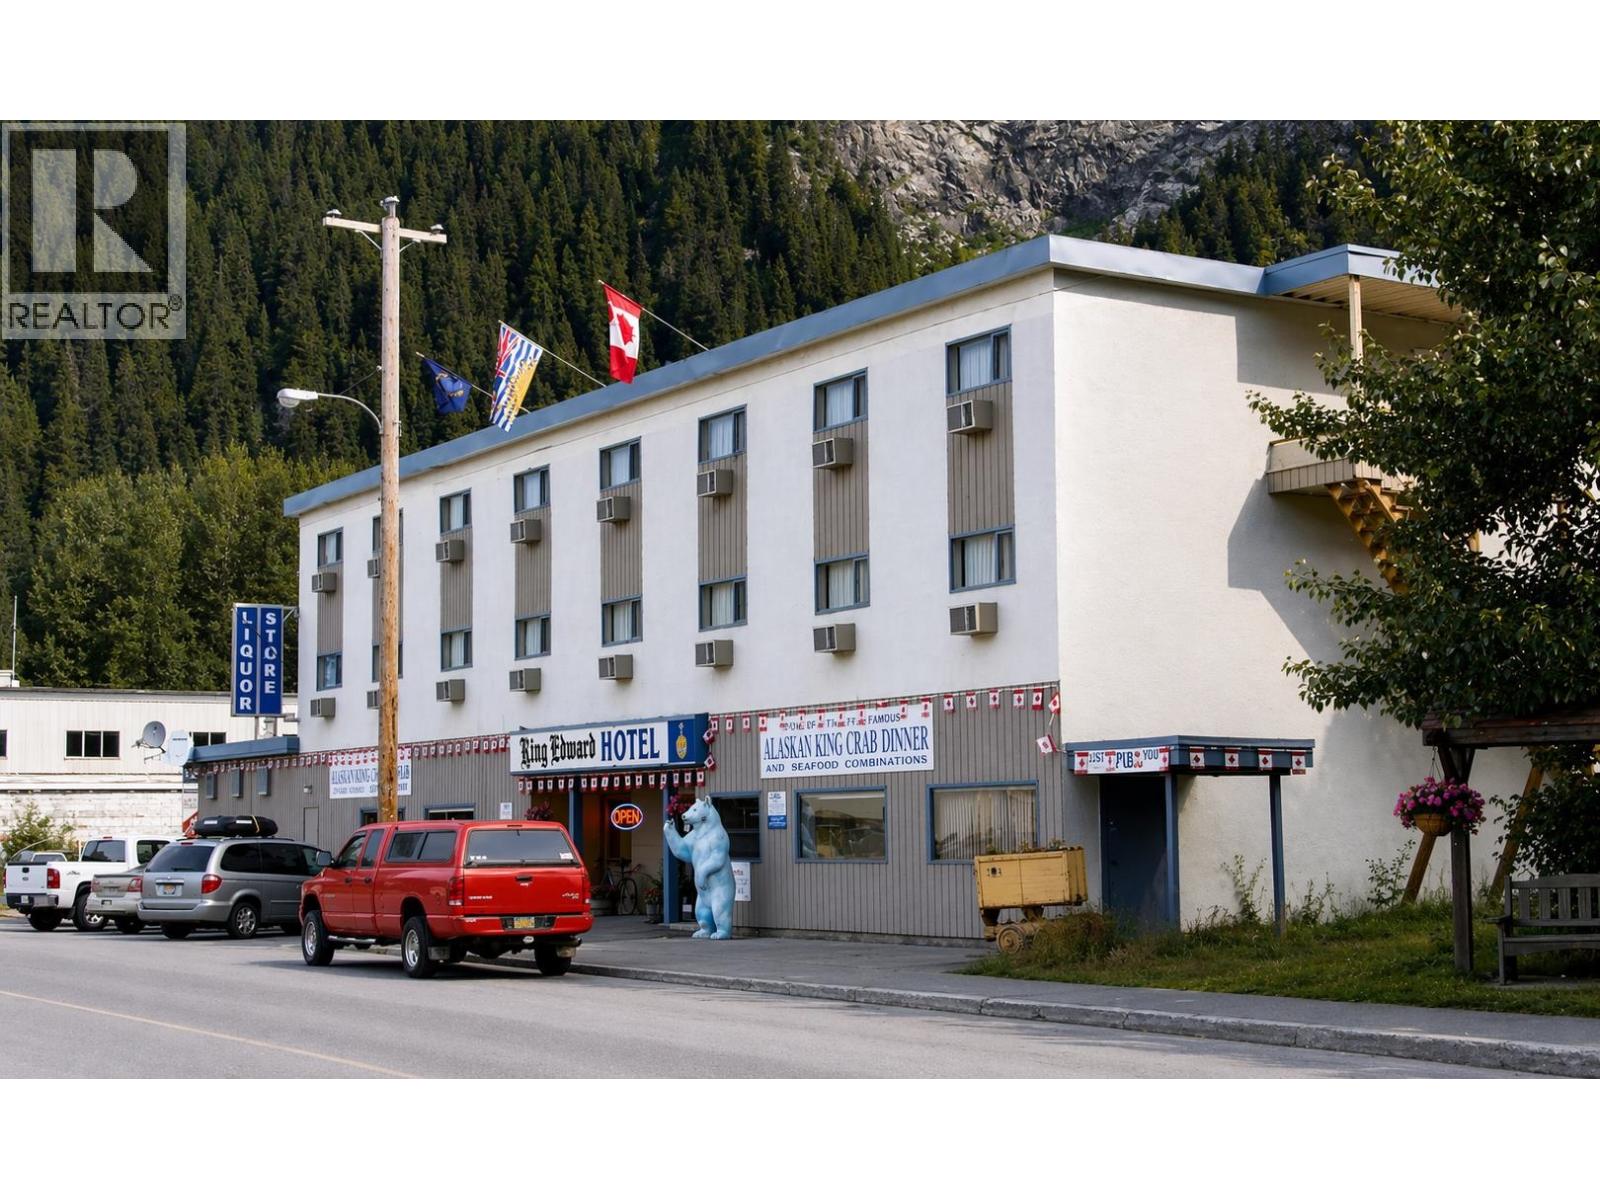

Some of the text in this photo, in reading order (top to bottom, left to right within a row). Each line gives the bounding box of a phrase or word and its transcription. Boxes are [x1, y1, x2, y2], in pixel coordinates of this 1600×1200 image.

[240, 611, 253, 711] LIQUOR
[264, 612, 277, 694] STORE
[868, 713, 901, 724] FAMOUS
[519, 727, 660, 769] King Edward HOTEL
[764, 725, 929, 760] ALASKAN KING CRAB DINNER
[766, 754, 928, 773] AND SEAFOOD COMBINATIONS
[614, 809, 640, 825] OPEN
